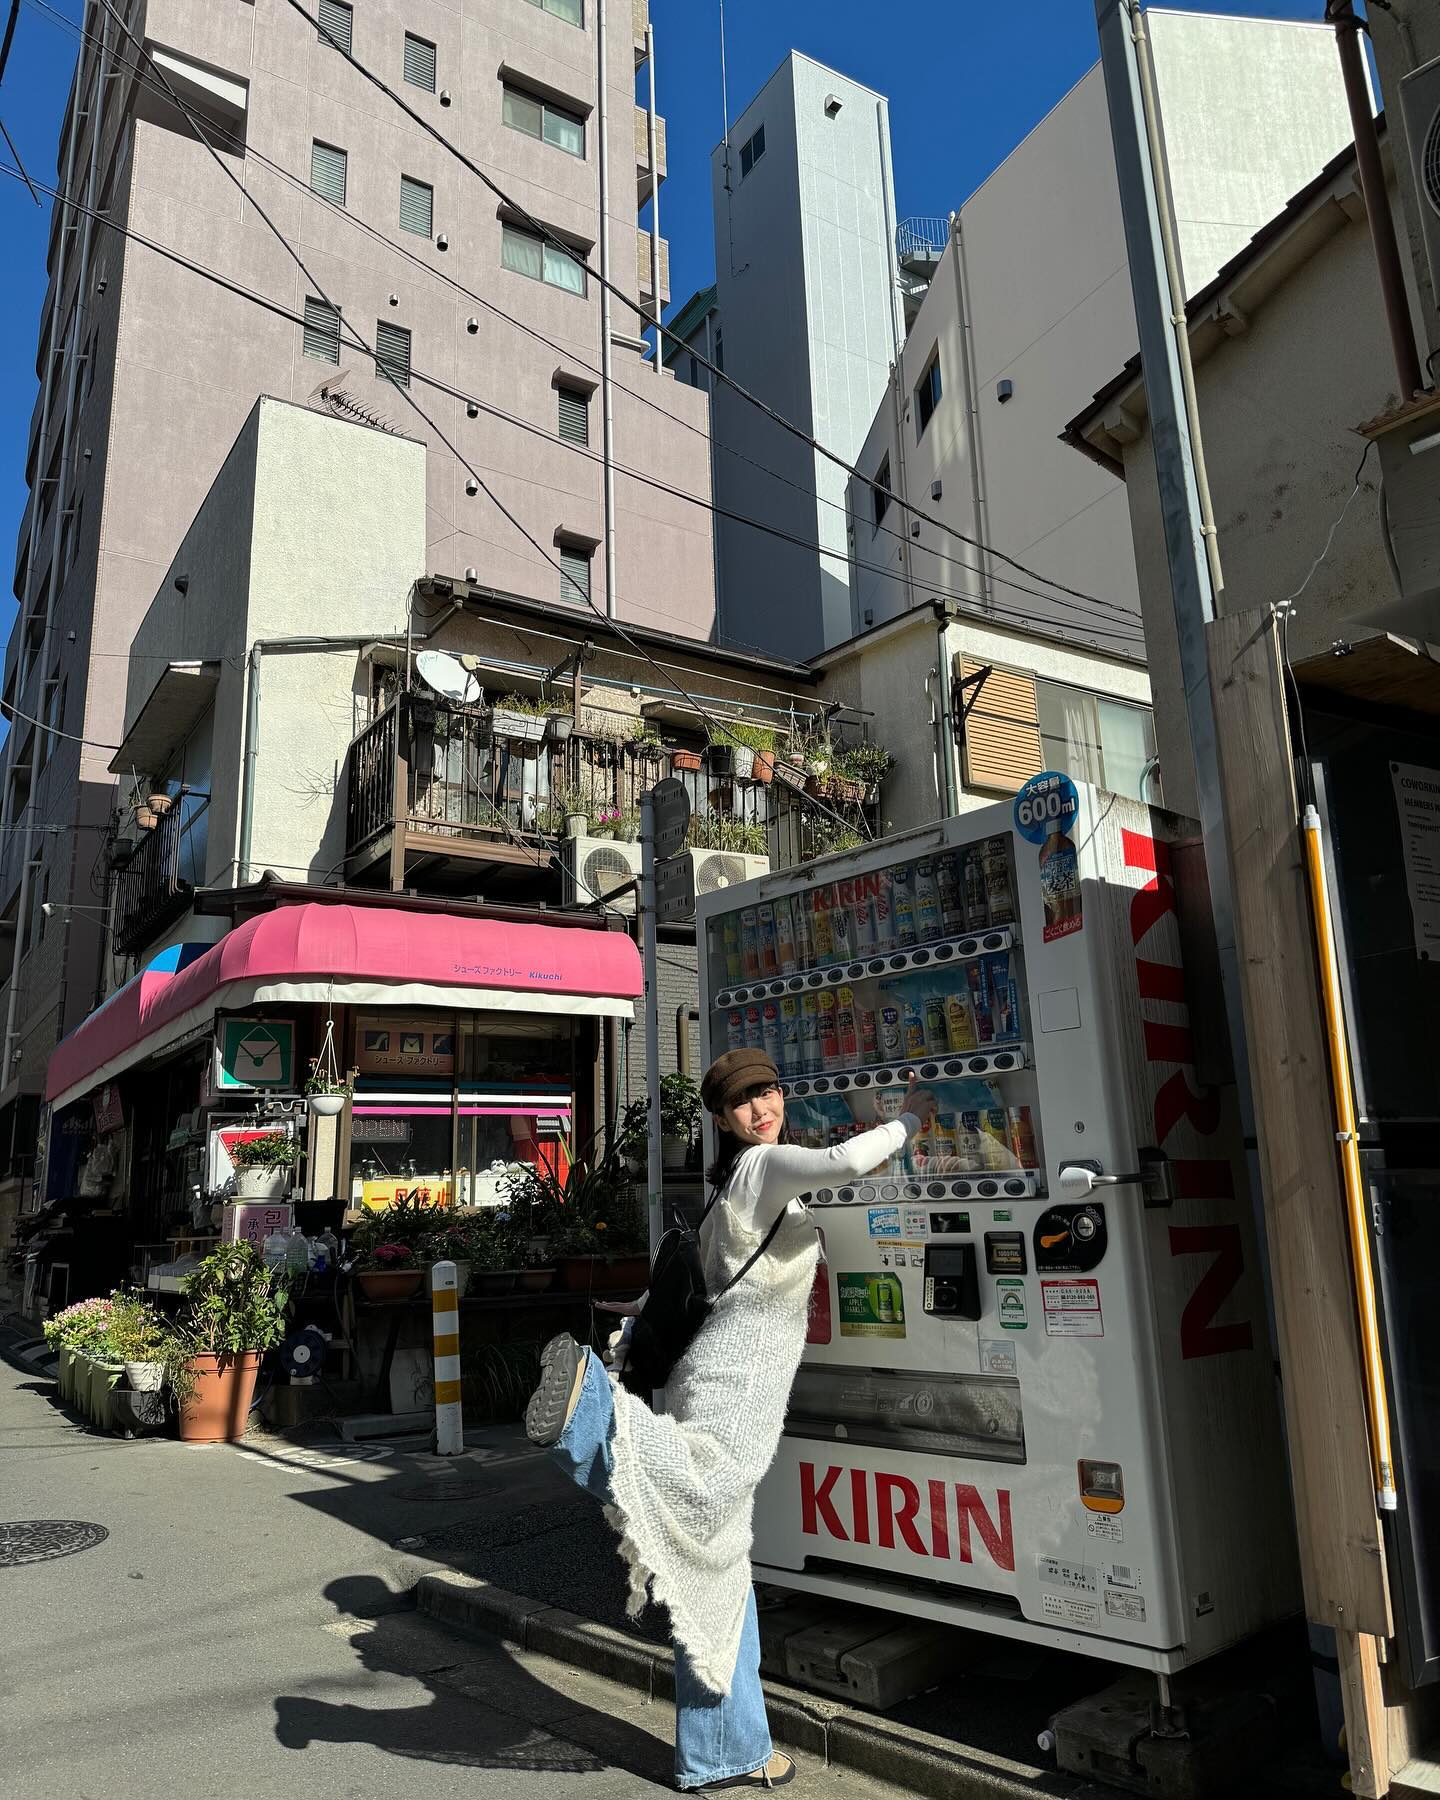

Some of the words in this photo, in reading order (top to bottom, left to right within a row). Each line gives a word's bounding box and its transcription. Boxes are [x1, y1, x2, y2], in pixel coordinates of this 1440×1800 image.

[1025, 775, 1061, 797] 大容量
[1018, 793, 1075, 826] 600ml
[813, 871, 881, 913] KIRIN
[528, 971, 562, 981] Kikuchi
[352, 1119, 404, 1137] OPEN
[799, 1461, 1016, 1572] KIRIN
